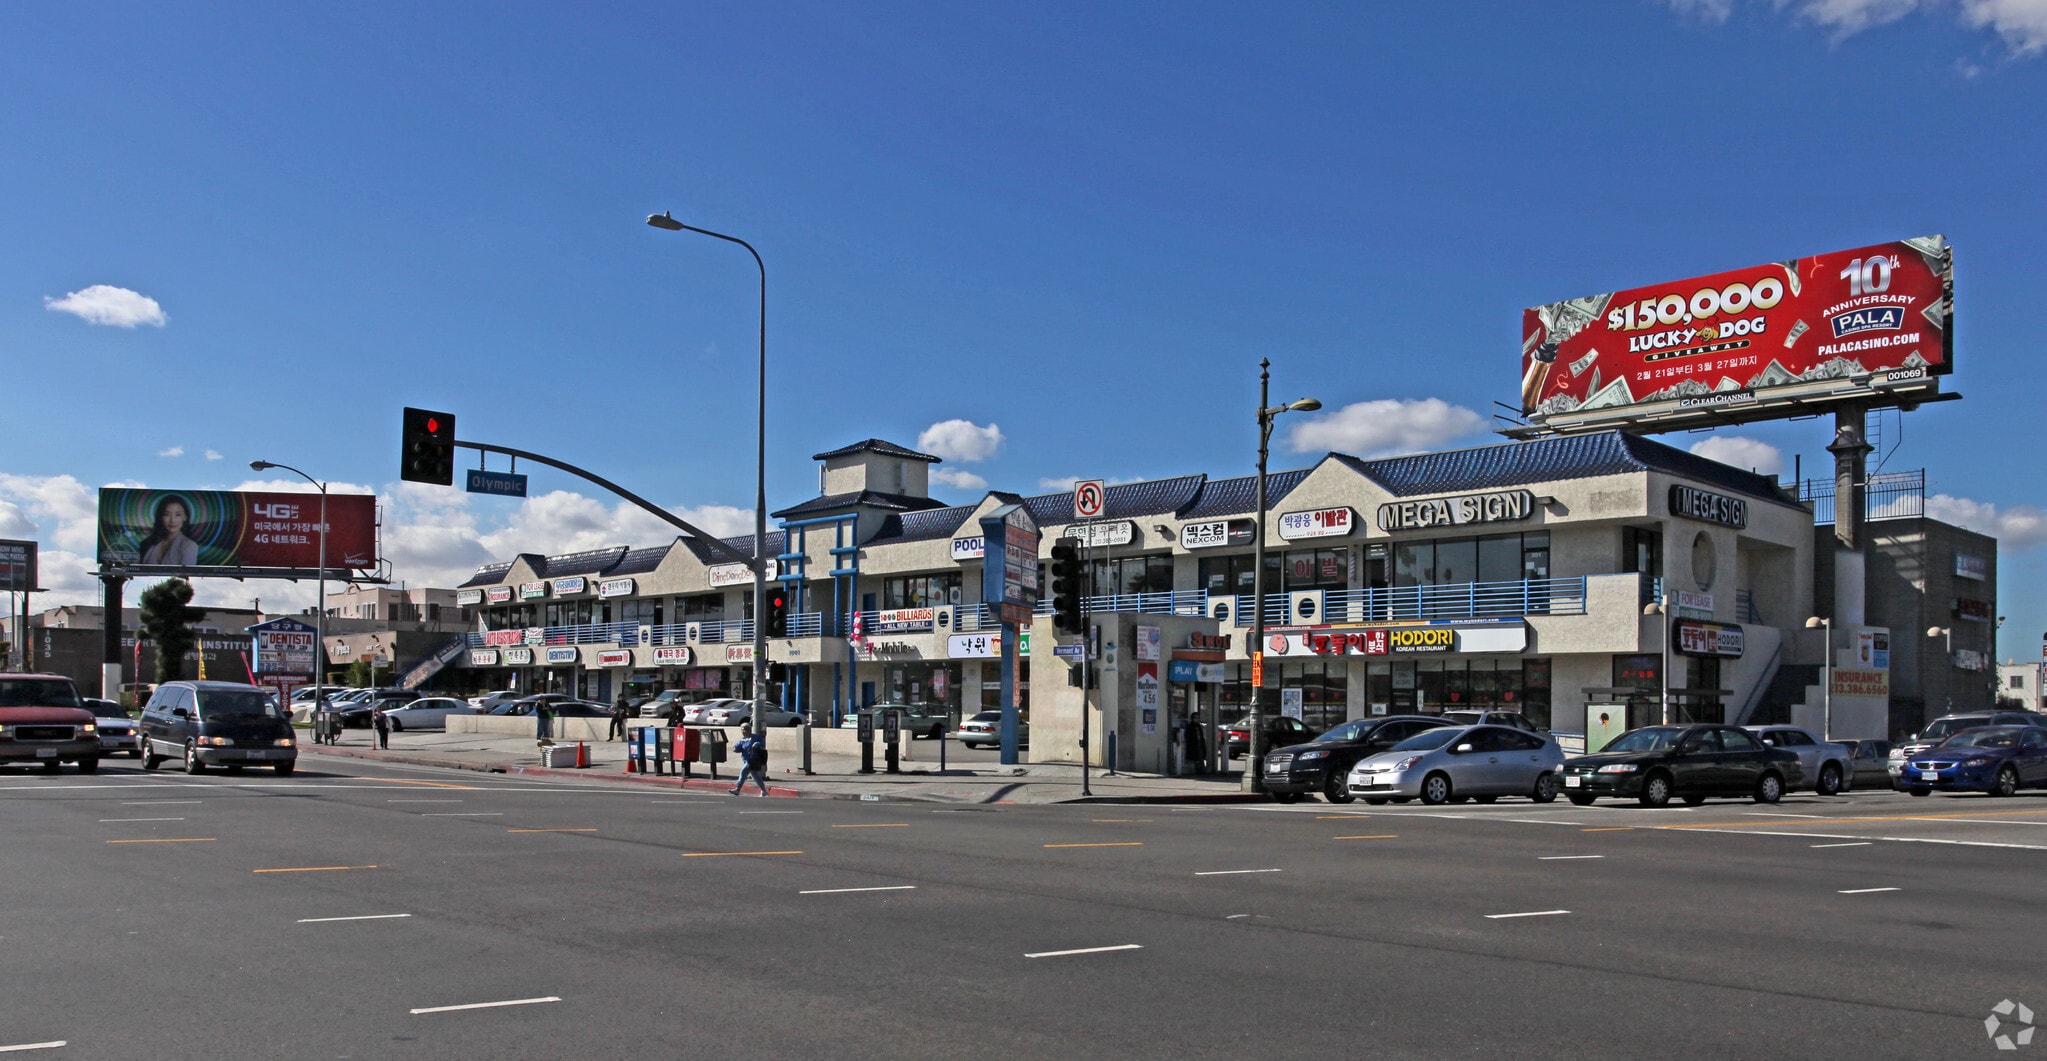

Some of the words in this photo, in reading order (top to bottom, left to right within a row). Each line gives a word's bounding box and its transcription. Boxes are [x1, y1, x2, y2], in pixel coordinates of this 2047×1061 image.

[1840, 254, 1901, 297] 10th
[1607, 276, 1784, 332] $150,000
[1822, 294, 1916, 318] ANNIVERSARY
[1838, 310, 1895, 330] PALA
[1629, 327, 1698, 353] LUCKY
[1719, 316, 1767, 339] DOG
[1841, 326, 1861, 335] CASINO
[1652, 341, 1744, 360] GIVEAWAY
[1818, 332, 1920, 356] PALACASINO.COM
[1636, 370, 1651, 381] 2월
[1655, 364, 1693, 378] 21일부터
[1697, 362, 1713, 372] 3월
[1717, 355, 1757, 369] 27일까지
[1888, 369, 1921, 381] 001069
[472, 475, 522, 492] Olympic
[254, 503, 290, 519] 4G
[290, 504, 300, 519] LTE
[1382, 499, 1451, 528] MEGA
[1460, 491, 1521, 522] SIGN
[1683, 486, 1717, 519] MEGA
[1721, 497, 1748, 527] SIGN
[254, 521, 291, 532] 미국에서
[292, 522, 311, 533] 가장
[1315, 509, 1348, 529] 이발관
[254, 534, 269, 544] 4G
[954, 539, 984, 552] POOL
[1186, 535, 1224, 544] NEXCOM
[1681, 593, 1693, 606] FOR
[1694, 594, 1711, 608] LEASE
[896, 609, 932, 621] BILLIARDS
[269, 633, 312, 645] DENTISTA
[1312, 633, 1364, 655] 호돌이
[1391, 629, 1453, 646] HODORI
[1717, 634, 1742, 645] HODORI
[549, 651, 574, 661] DENTISTRY
[1174, 666, 1193, 676] PLAY
[1834, 671, 1883, 683] INSURANCE
[1138, 679, 1157, 690] Marlboro
